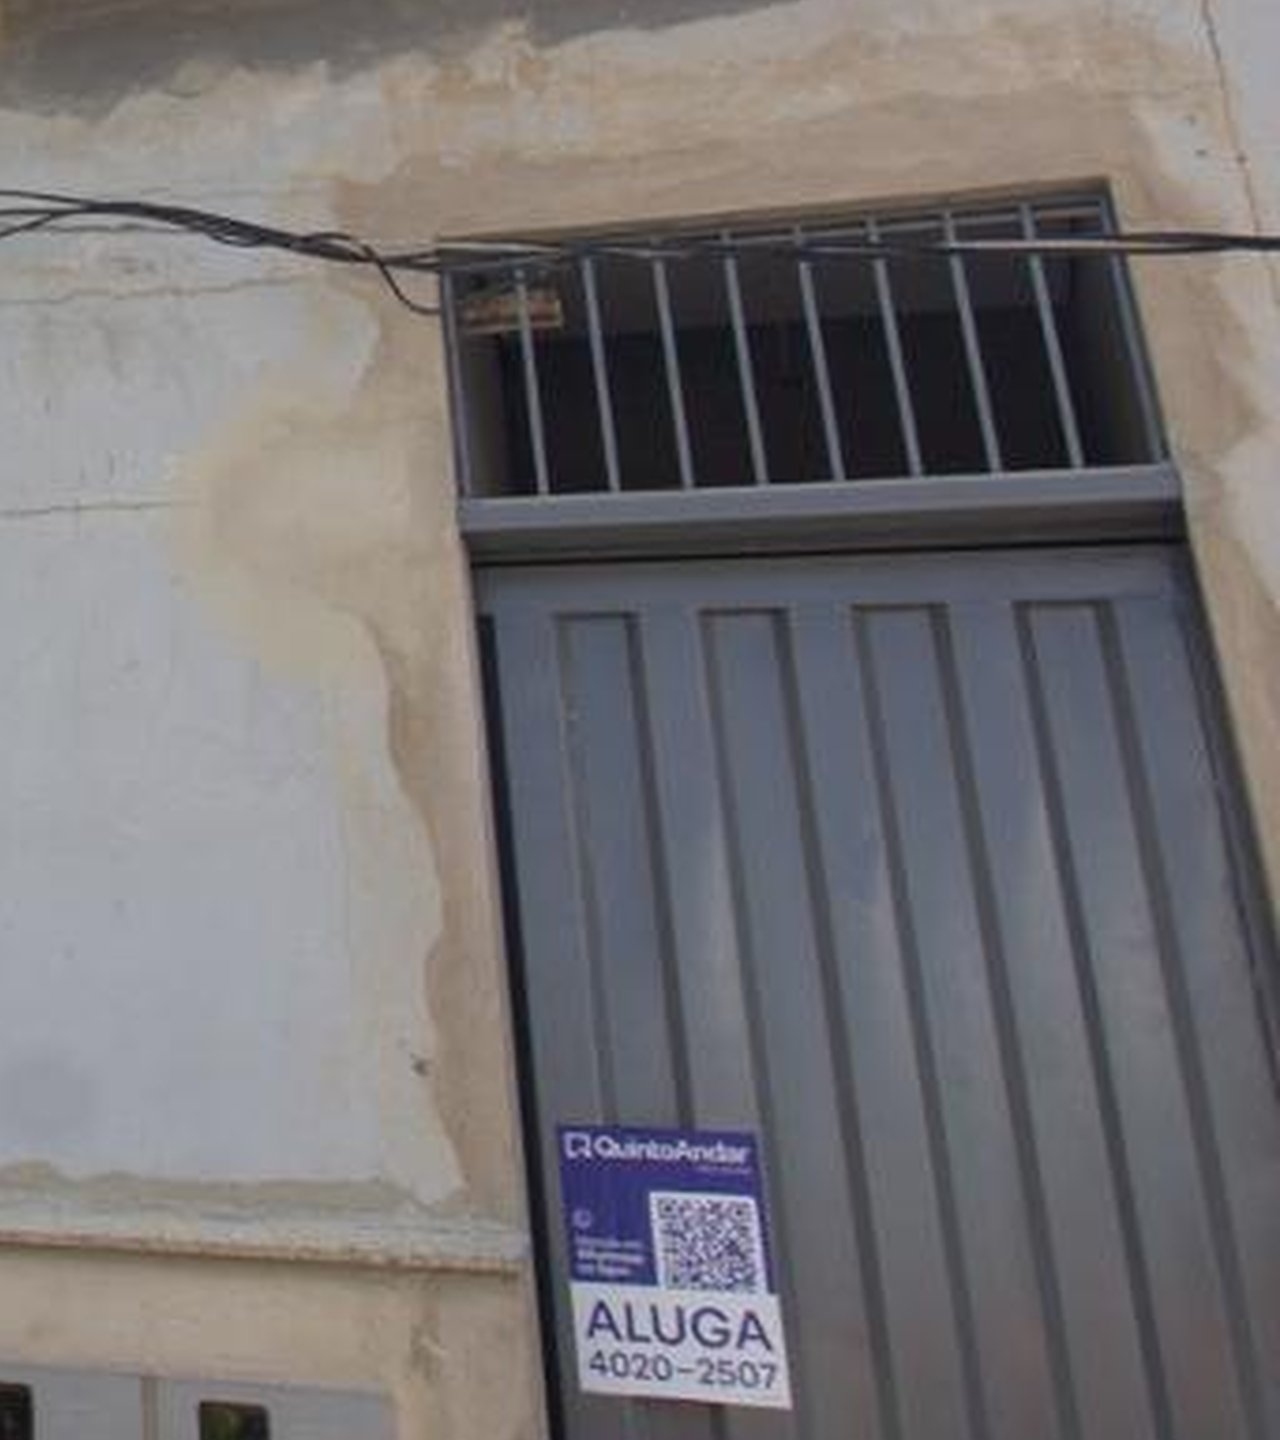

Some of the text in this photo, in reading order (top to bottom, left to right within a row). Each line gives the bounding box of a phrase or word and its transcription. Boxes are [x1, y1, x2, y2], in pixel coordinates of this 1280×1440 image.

[593, 1135, 751, 1164] QuintoAndar
[587, 1300, 772, 1352] ALUGA
[589, 1350, 778, 1389] 4020-2507
